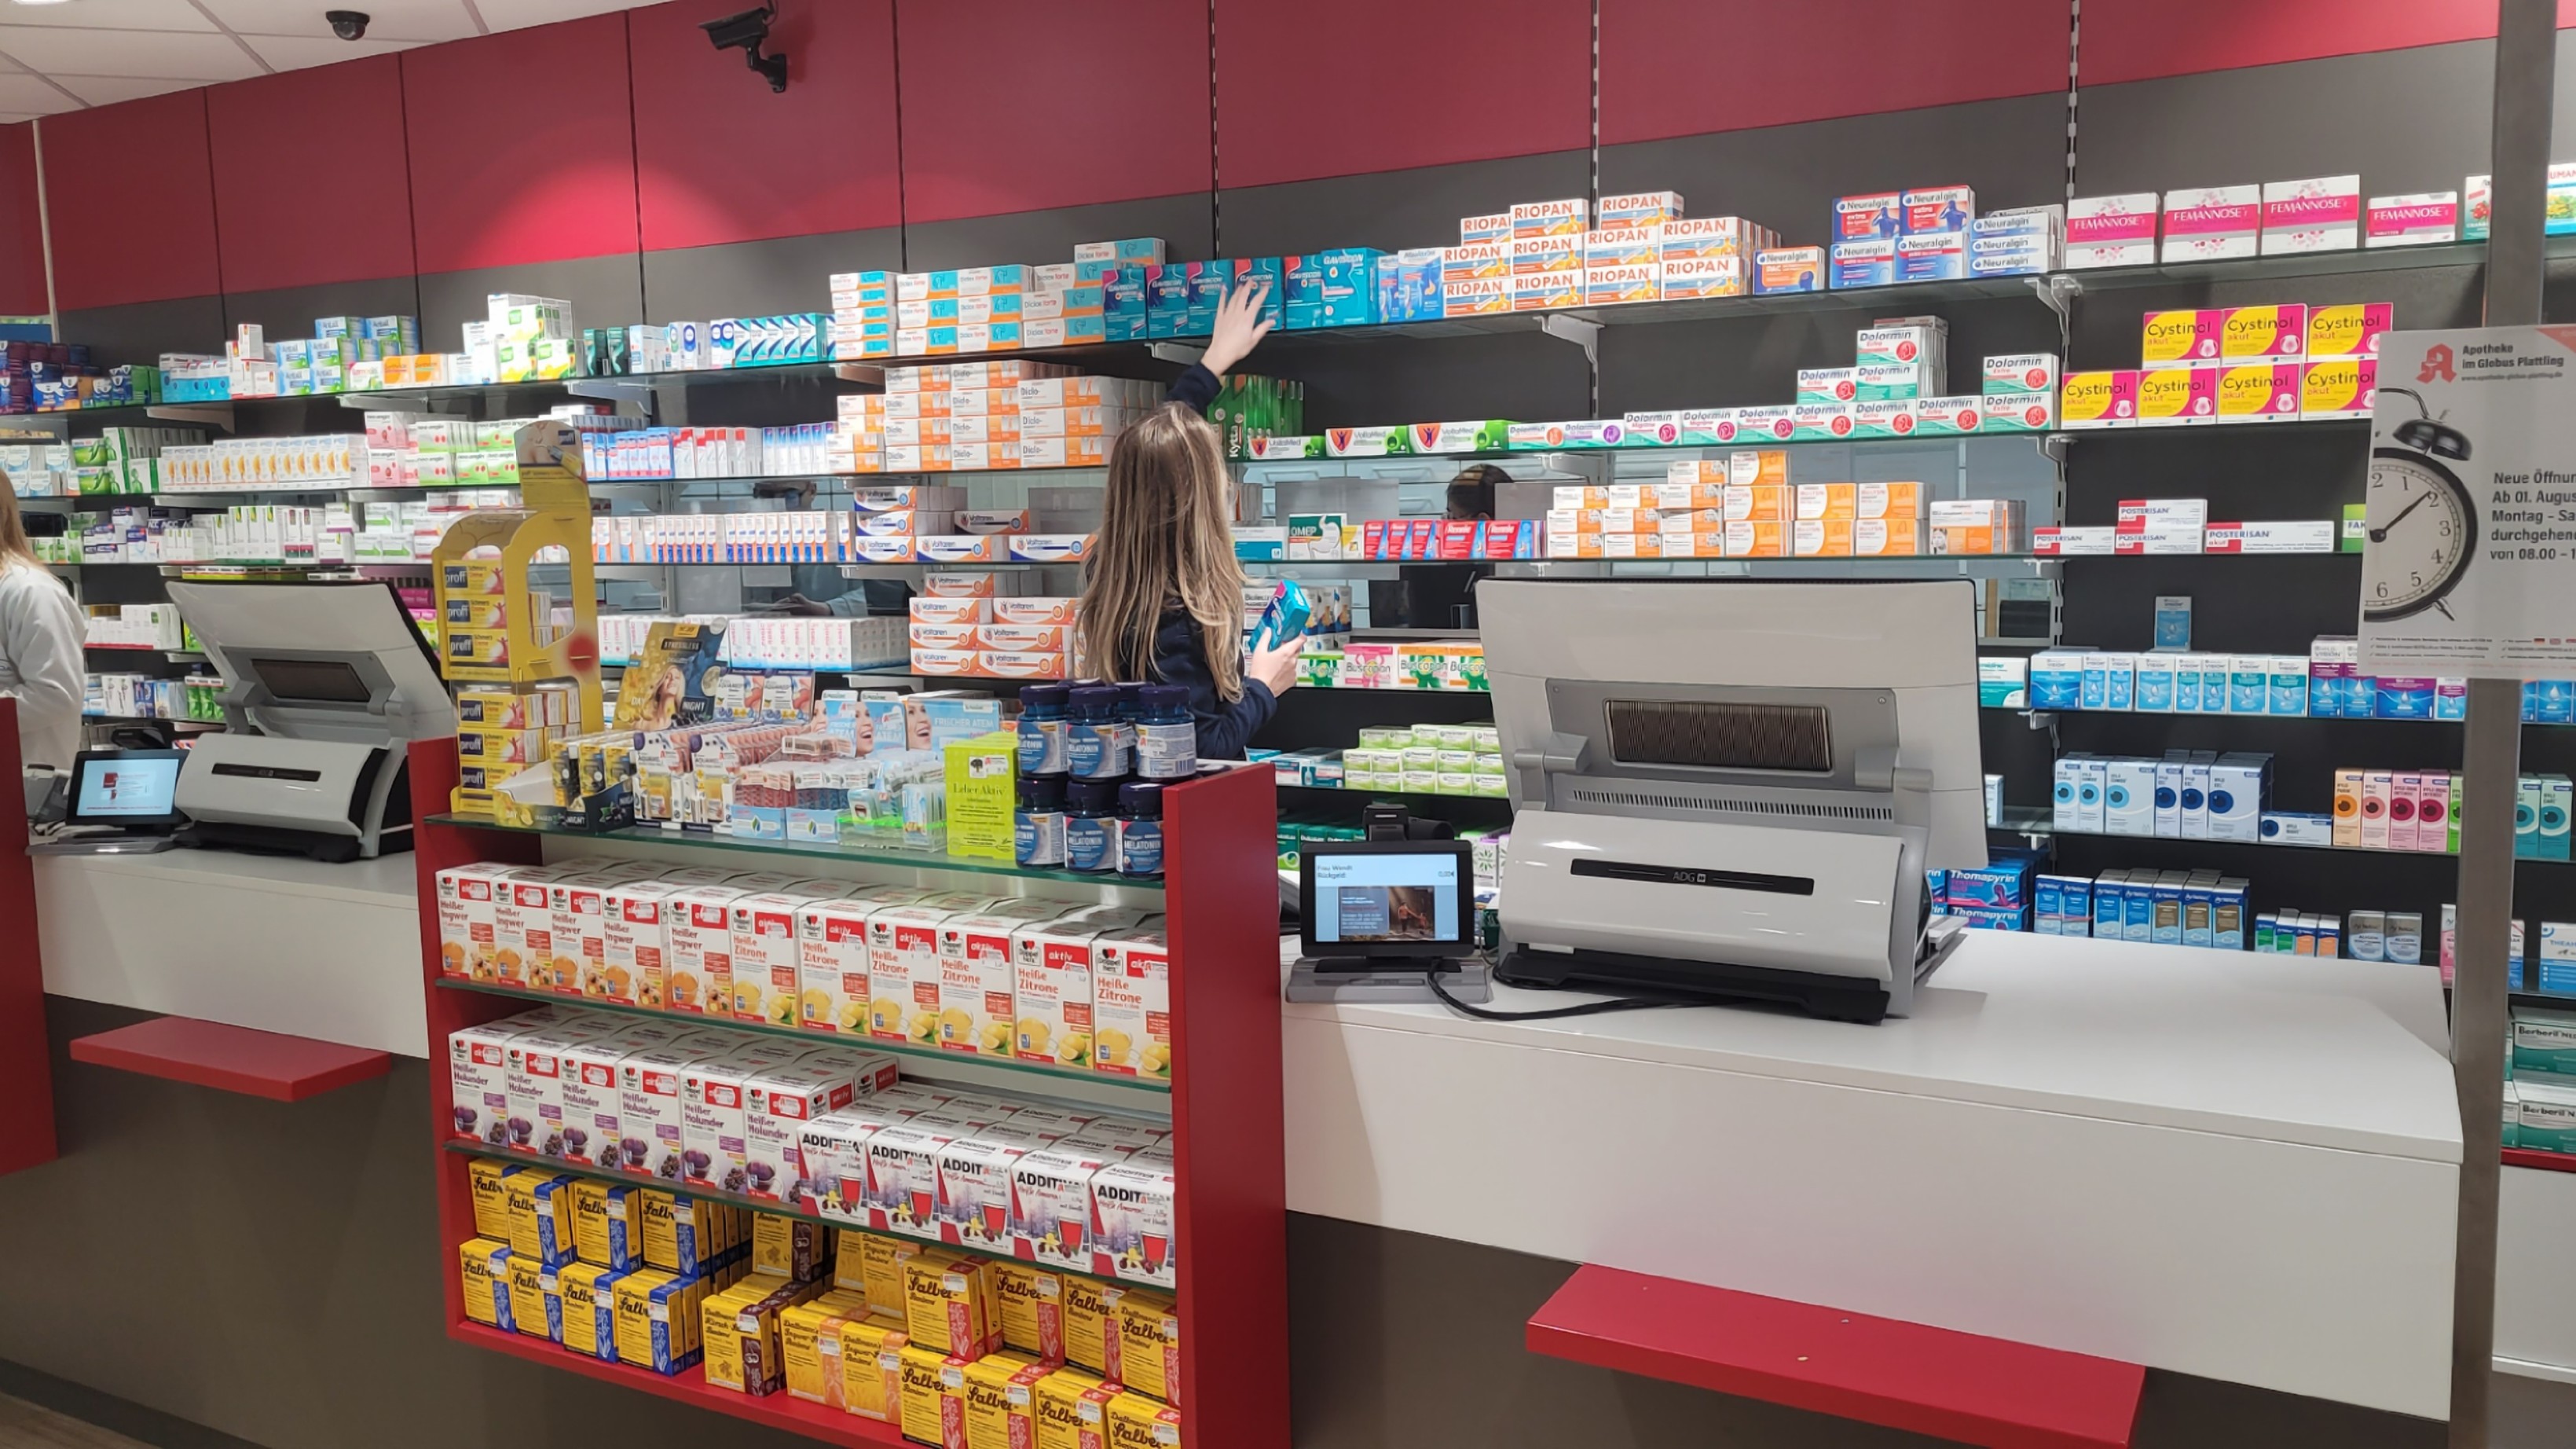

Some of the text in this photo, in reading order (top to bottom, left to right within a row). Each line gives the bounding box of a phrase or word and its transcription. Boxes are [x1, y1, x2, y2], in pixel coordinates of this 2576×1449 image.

[1602, 194, 1662, 211] RIOPAN
[1847, 198, 1889, 211] Neuralgin
[2270, 197, 2343, 213] FEMANNOSE
[1515, 202, 1573, 219] RIOPAN
[2174, 206, 2242, 222] FEMANNOSE
[2373, 207, 2442, 221] FEMANNOSE
[1664, 219, 1727, 236] RIOPAN
[2074, 215, 2140, 229] FEMANNOSE
[1588, 228, 1648, 244] RIOPAN
[1514, 237, 1572, 255] RIOPAN
[1323, 253, 1364, 265] GAVISCON
[1444, 245, 1501, 262] RIOPAN
[1766, 251, 1808, 262] Neuralgin
[1665, 259, 1729, 276] RIOPAN
[1589, 267, 1649, 284] RIOPAN
[1446, 281, 1503, 296] RIOPAN
[1515, 274, 1573, 291] RIOPAN
[2148, 321, 2211, 338] Cystinol
[2227, 316, 2293, 332] Cystinol
[2313, 316, 2380, 331] Cystinol
[1860, 331, 1911, 342] Dolormin
[2148, 336, 2168, 345] akut
[2227, 332, 2250, 340] akut
[2463, 343, 2513, 355] Apotheke
[1986, 357, 2041, 369] Dolormin
[2462, 355, 2564, 369] im Globus Plattling
[1800, 369, 1850, 381] Dolormin
[1858, 365, 1910, 377] Dolormin
[2222, 376, 2288, 391] Cystinol
[2307, 372, 2375, 387] Cystinol
[2065, 382, 2127, 397] Cystinol
[2143, 379, 2206, 394] Cystinol
[1986, 394, 2041, 405] Dolormin
[1795, 405, 1845, 416] Dolormin
[2494, 472, 2529, 484] Neue
[2493, 490, 2510, 503] Ab
[2515, 491, 2532, 503] 01.
[2492, 510, 2543, 525] Montag
[2559, 509, 2575, 521] Sa
[2118, 534, 2166, 542] POSTERISAN
[2209, 530, 2270, 540] POSTERISAN
[2490, 551, 2514, 559] von
[2519, 548, 2556, 559] 08.00
[445, 569, 466, 584] proff
[447, 604, 468, 620] proff
[449, 636, 472, 652] proff
[1347, 662, 1391, 674] Buscopan
[1401, 661, 1448, 673] Buscopan
[460, 704, 482, 720] proff
[683, 702, 705, 710] NIGHT
[935, 717, 993, 728] FRISCHER ATEM
[461, 738, 482, 754] proff
[462, 769, 485, 783] proff
[953, 783, 1004, 796] Leber Aktiv
[1124, 840, 1161, 850] MELATONIN
[1951, 870, 2015, 882] Thomapyrin
[441, 911, 468, 922] Ingwer
[1953, 907, 2017, 920] Thomapyrin
[496, 918, 524, 930] Ingwer
[829, 926, 851, 935] aktiv
[604, 933, 634, 945] Ingwer
[733, 935, 757, 947] Heiße
[735, 945, 768, 959] Zitrone
[803, 942, 828, 954] Heiße
[804, 953, 839, 967] Zitrone
[871, 950, 898, 963] Heiße
[1048, 951, 1073, 961] aktiv
[872, 961, 909, 974] Zitrone
[941, 959, 969, 972] Heiße
[942, 970, 980, 985] Zitrone
[1017, 969, 1047, 981] Heiße
[1019, 980, 1059, 994] Zitrone
[1097, 978, 1129, 990] Heiße
[1097, 989, 1142, 1004] Zitrone
[2519, 1026, 2559, 1036] Berberil
[454, 1073, 488, 1086] Holunder
[508, 1083, 544, 1097] Holunder
[563, 1093, 599, 1107] Holunder
[622, 1092, 648, 1103] Heißer
[623, 1102, 661, 1117] Holunder
[684, 1102, 711, 1116] Heißer
[2523, 1105, 2565, 1114] Berberil
[684, 1113, 724, 1128] Holunder
[748, 1124, 790, 1140] Holunder
[802, 1133, 860, 1154] ADDIA
